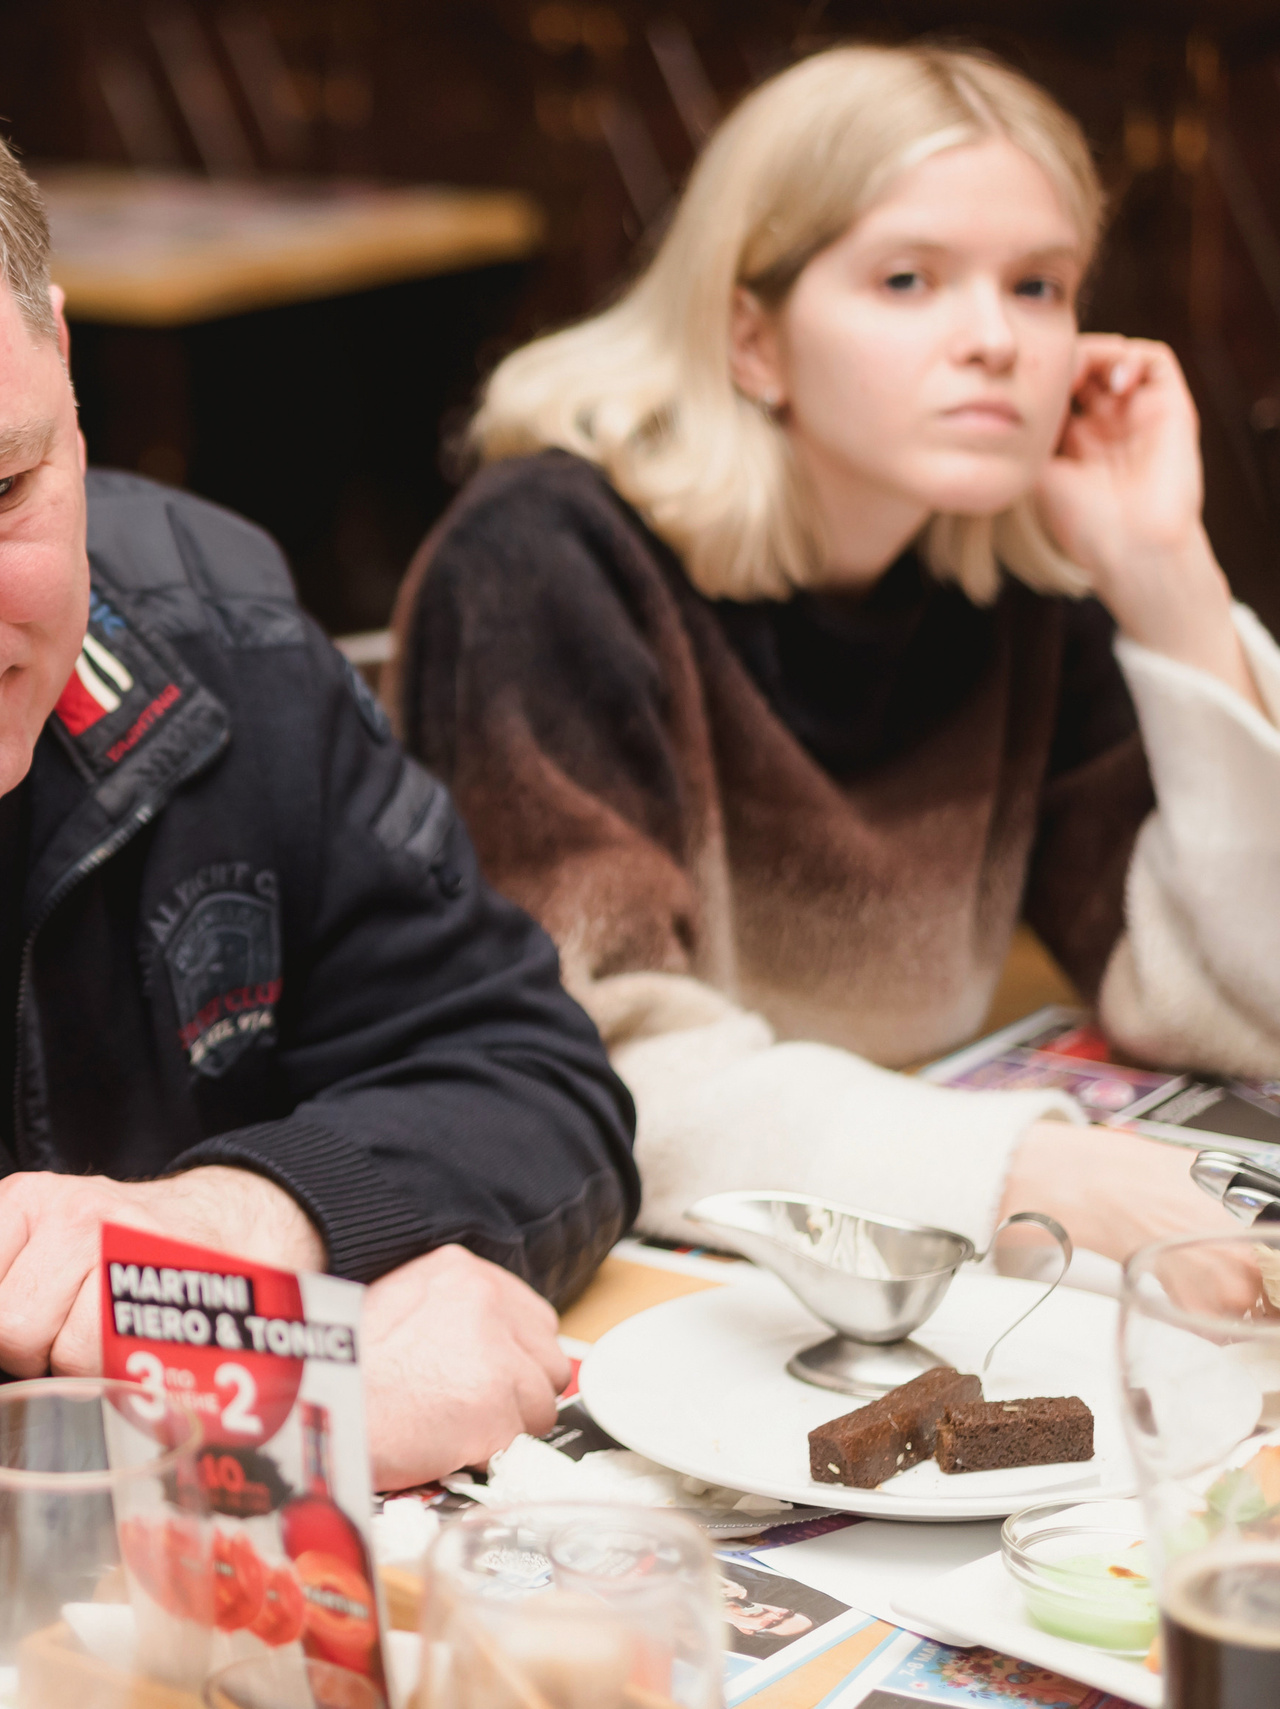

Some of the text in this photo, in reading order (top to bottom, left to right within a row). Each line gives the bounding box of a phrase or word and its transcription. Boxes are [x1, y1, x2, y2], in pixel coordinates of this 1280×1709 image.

[108, 1261, 251, 1312] MARTINI
[113, 1300, 354, 1360] FIERO & TONIC
[125, 1350, 166, 1420] 3
[213, 1361, 264, 1436] 2
